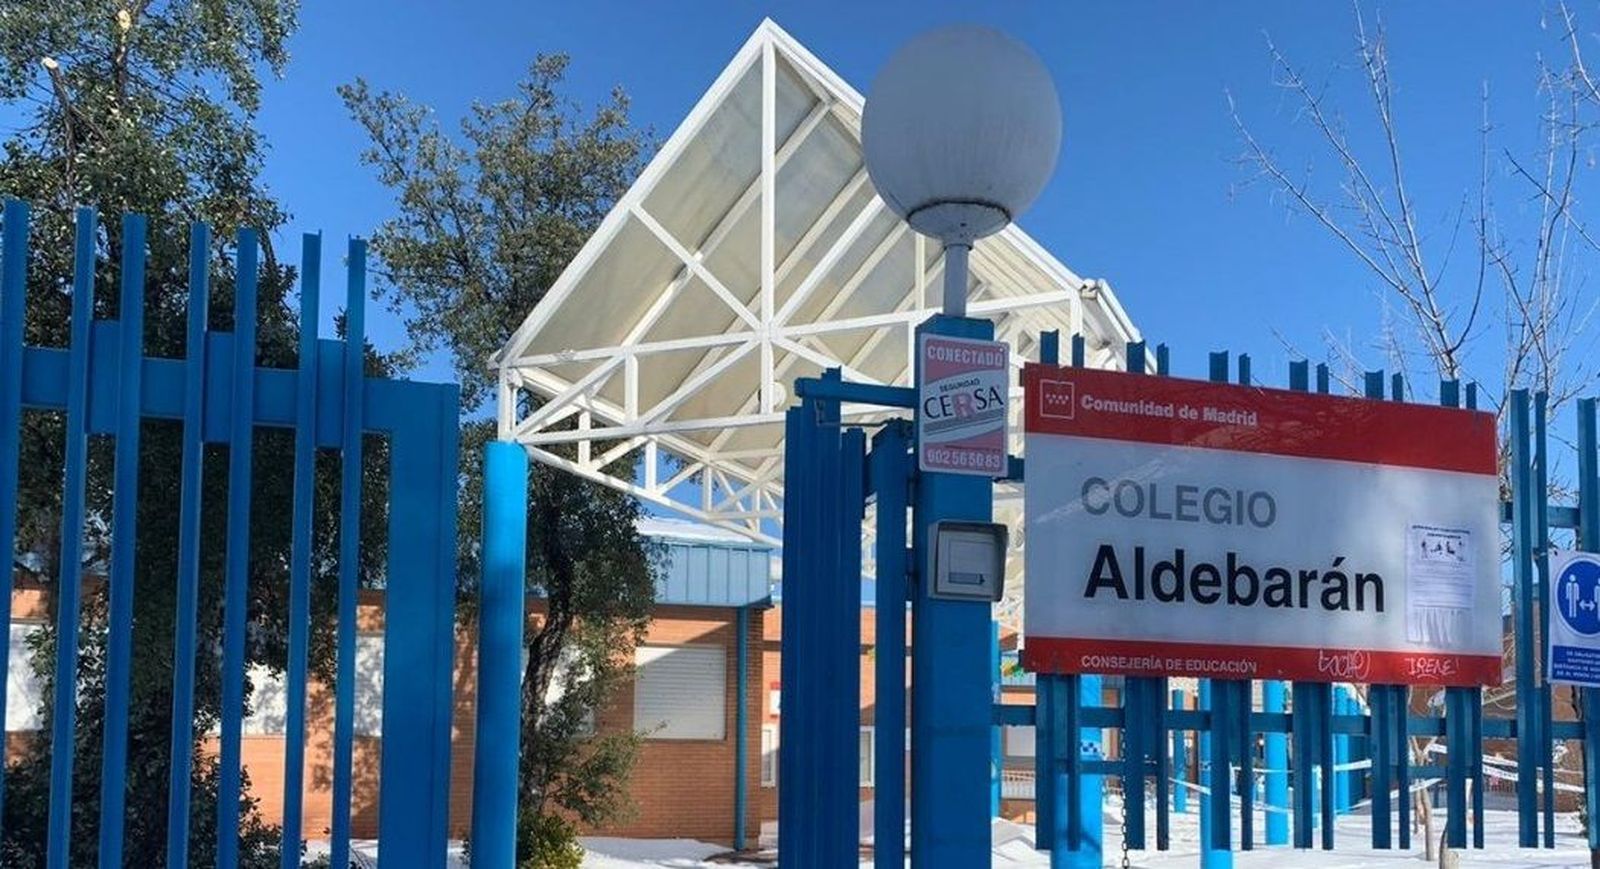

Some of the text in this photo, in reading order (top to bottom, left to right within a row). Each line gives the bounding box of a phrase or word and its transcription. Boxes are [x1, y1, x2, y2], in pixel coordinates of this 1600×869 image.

[927, 345, 1003, 366] CONECTADO
[924, 386, 1004, 419] CERSA
[1081, 394, 1258, 427] Comunidad de Madrid
[1081, 476, 1277, 528] COLEGIO
[1083, 544, 1385, 613] Aldebarán
[1081, 655, 1257, 674] CONSEJERÍA DE EDUCACIÓN
